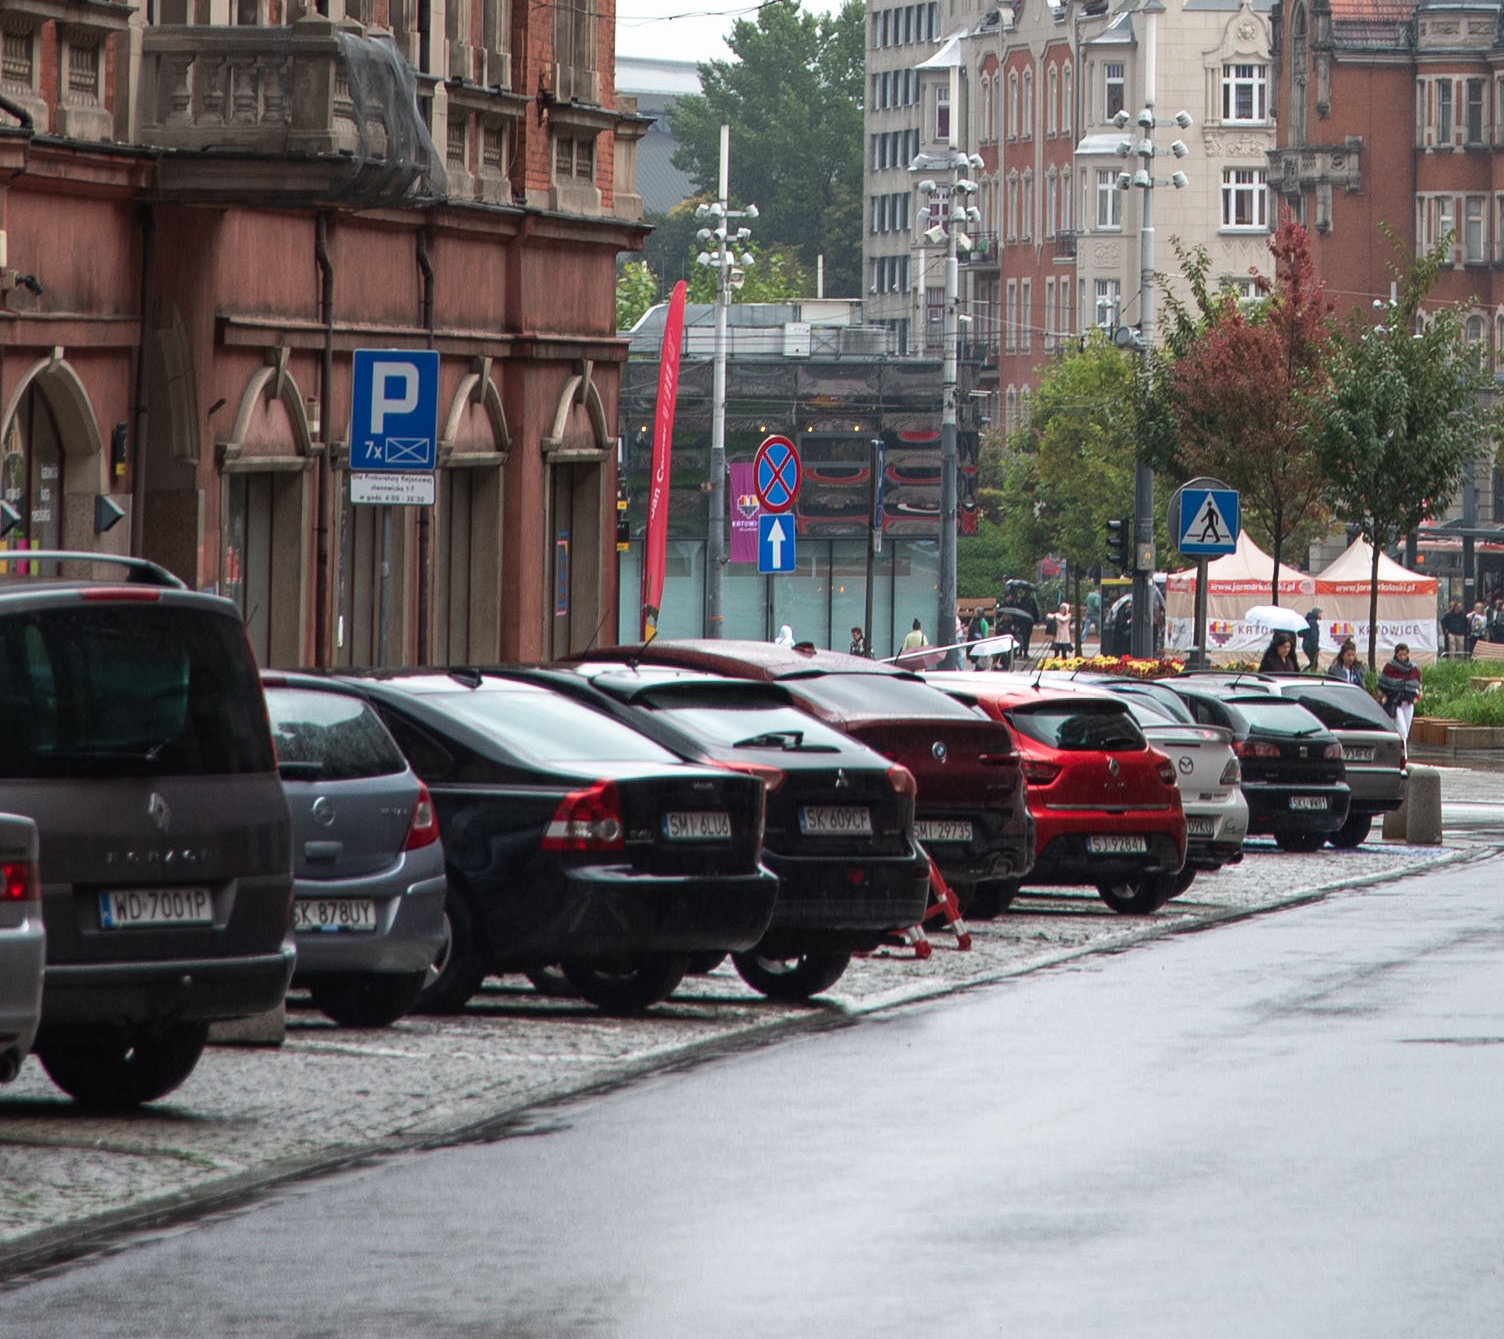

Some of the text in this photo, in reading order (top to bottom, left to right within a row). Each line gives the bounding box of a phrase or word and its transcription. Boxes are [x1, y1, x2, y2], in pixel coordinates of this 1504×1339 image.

[370, 361, 420, 435] P
[700, 814, 729, 835] 6LU6
[806, 807, 868, 829] SK 609CF
[937, 821, 972, 839] 29735
[114, 890, 206, 921] WD 7001P
[318, 900, 371, 924] 878UY
